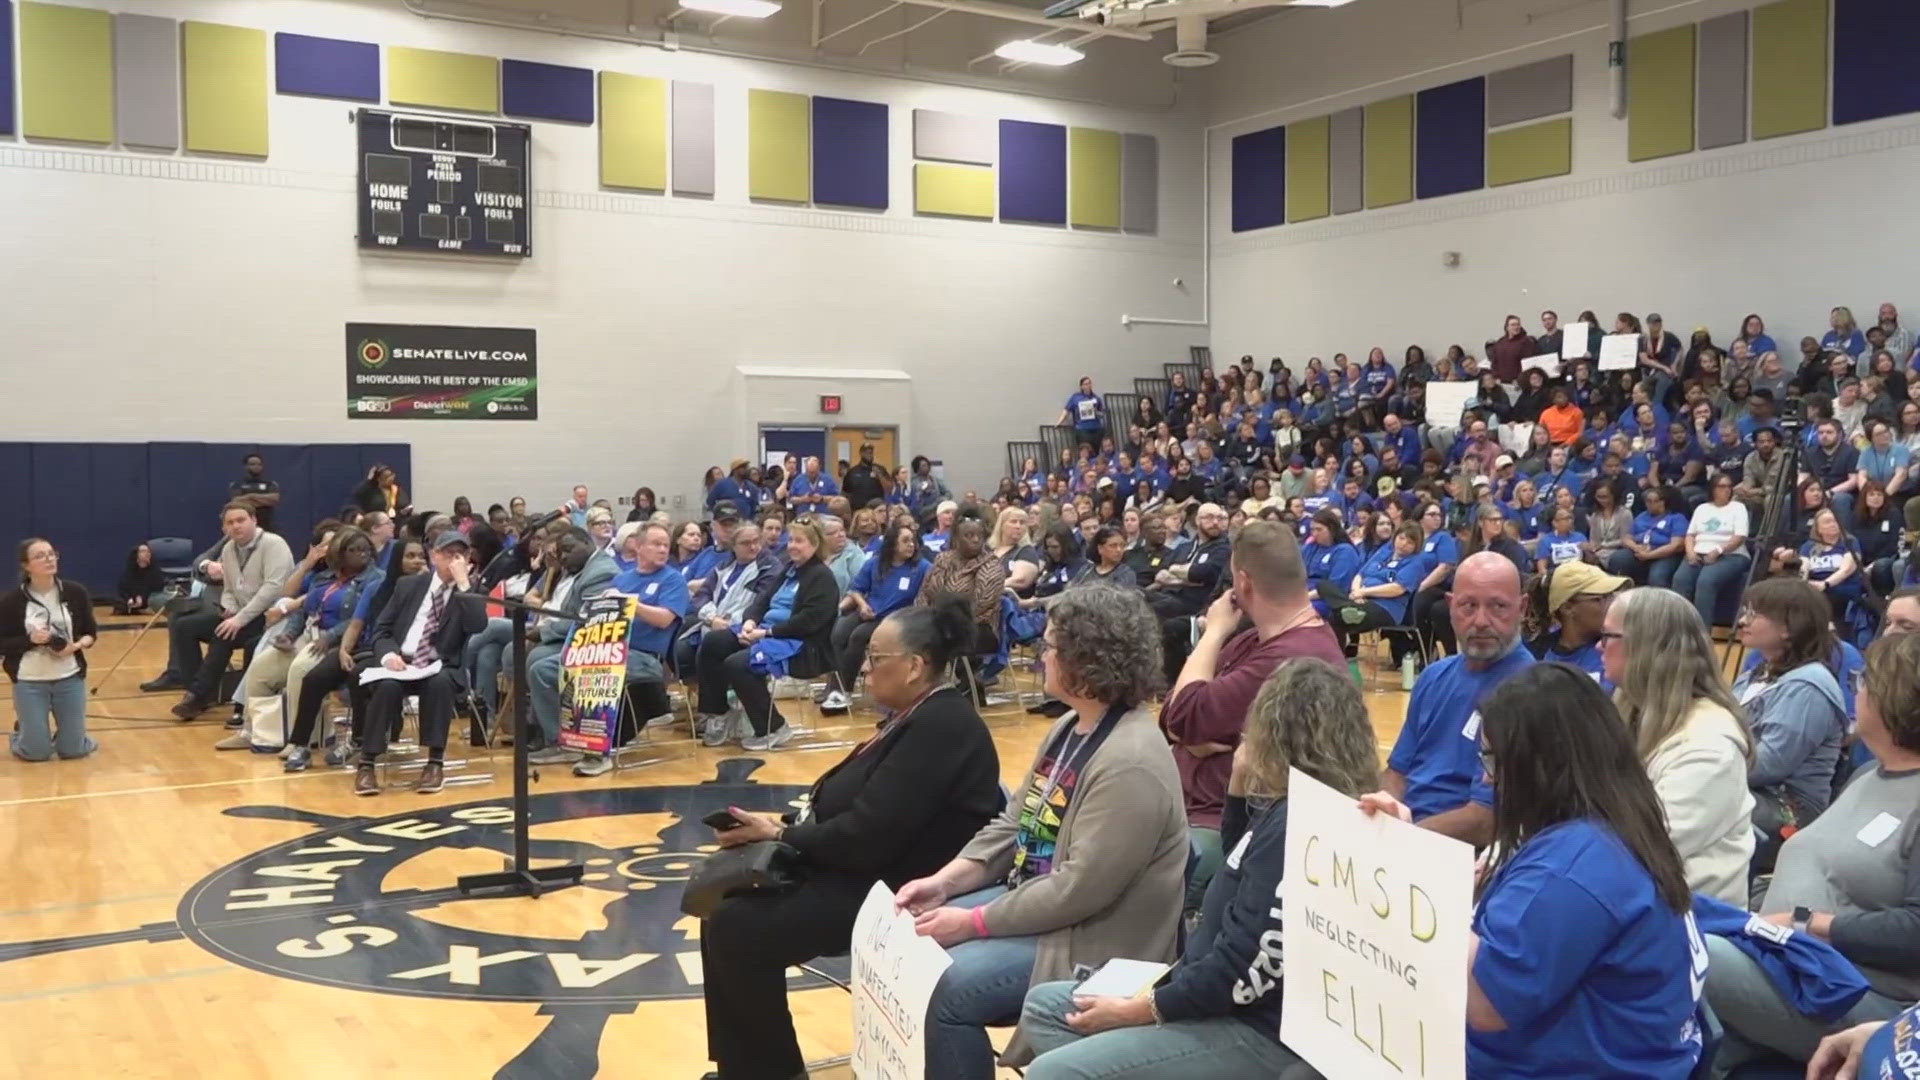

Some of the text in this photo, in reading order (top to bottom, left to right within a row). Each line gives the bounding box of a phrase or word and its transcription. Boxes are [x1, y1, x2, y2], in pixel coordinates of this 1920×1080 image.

[427, 169, 461, 182] PERIOD
[370, 184, 408, 200] HOME
[371, 199, 401, 211] FOULS
[474, 192, 523, 209] VISITOR
[428, 203, 441, 214] NO
[461, 206, 467, 216] F
[484, 208, 513, 220] FOULS
[378, 235, 398, 245] WON
[438, 239, 462, 250] GAME
[504, 244, 522, 253] WON
[393, 348, 528, 361] SENATELIVE.COM
[356, 374, 528, 387] SHOWCASING THE BEST OF THE CMSD
[357, 401, 392, 412] BGSU
[571, 621, 628, 648] STAFF
[565, 642, 624, 667] DOOMS
[577, 688, 618, 698] FUTURES
[225, 806, 529, 912] HAYES
[1304, 835, 1437, 943] CMSD
[1305, 906, 1418, 990] NEGLECTING
